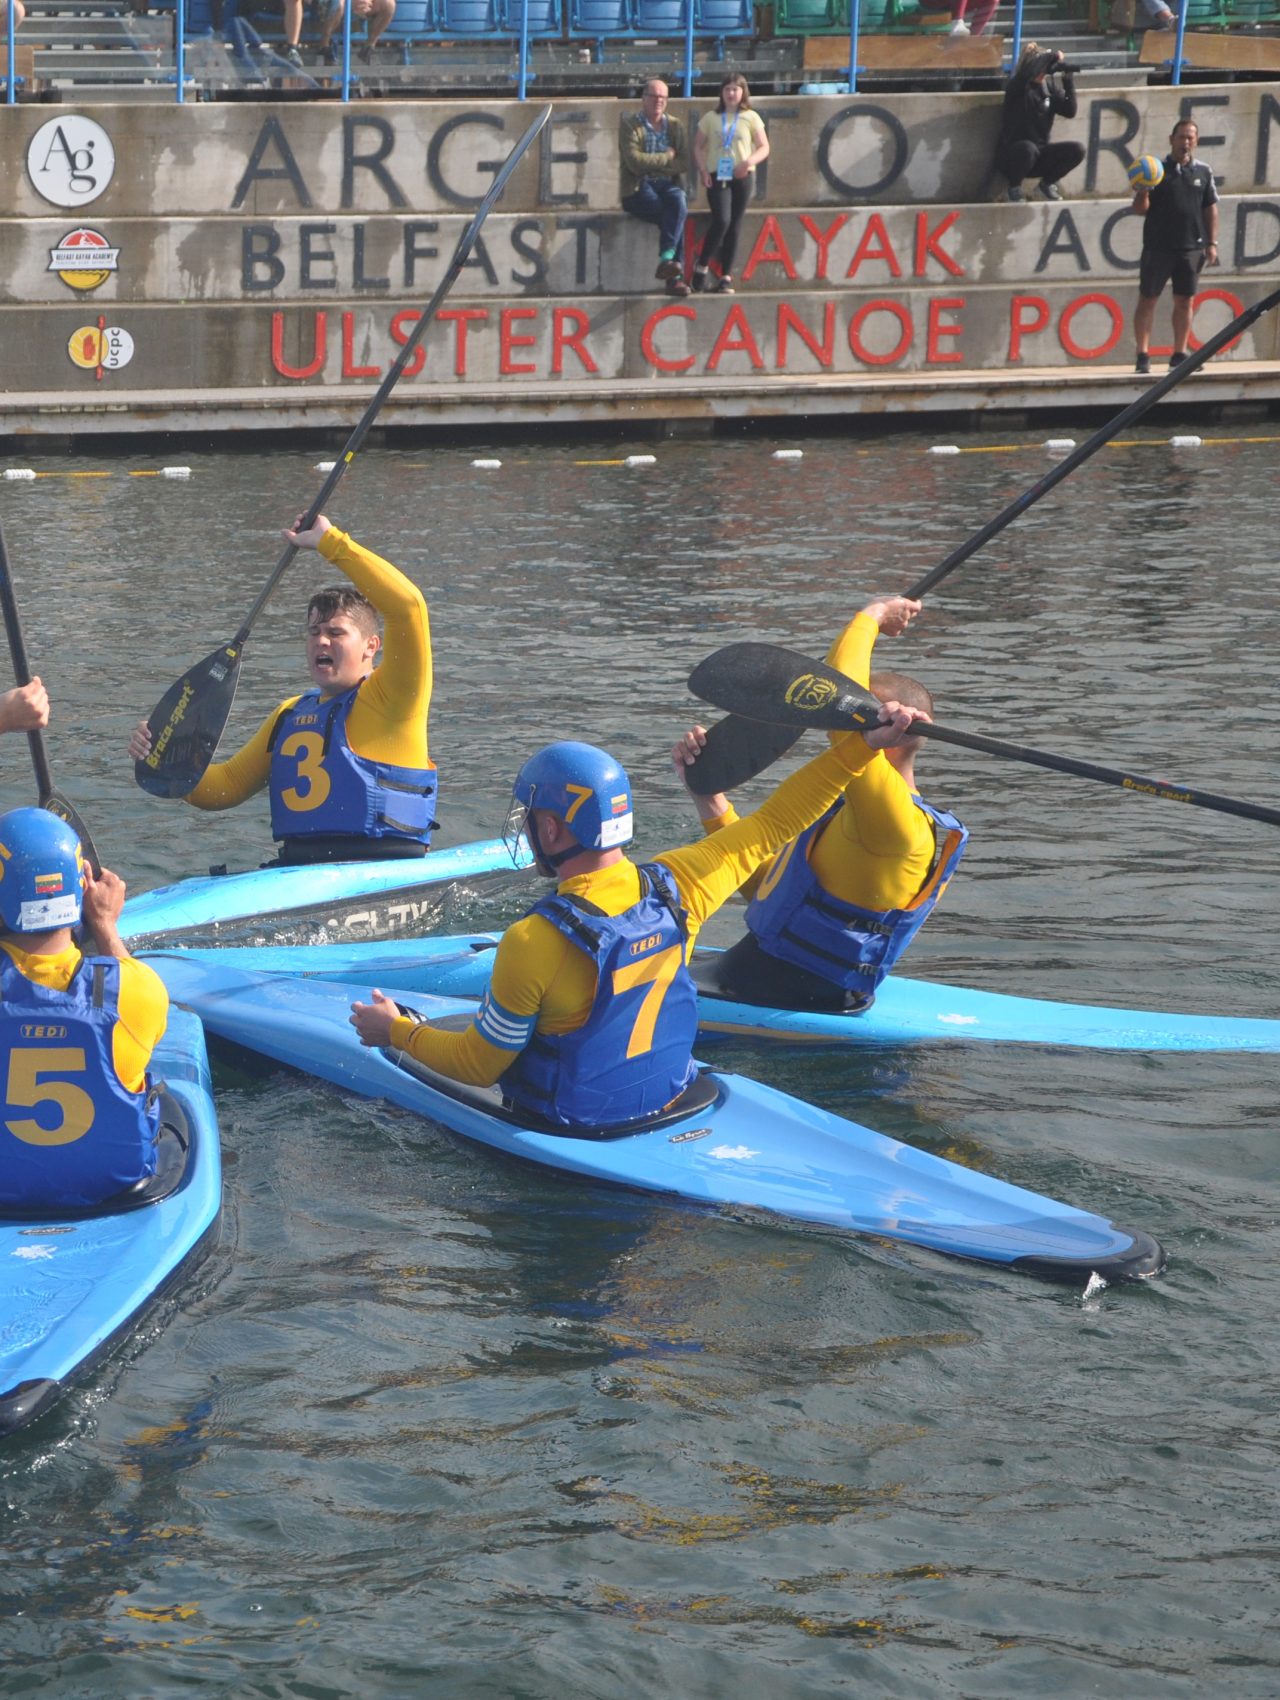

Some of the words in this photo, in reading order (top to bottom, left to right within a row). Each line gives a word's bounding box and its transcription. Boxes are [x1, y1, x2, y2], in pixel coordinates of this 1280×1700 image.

[40, 125, 96, 193] Ag
[241, 217, 604, 290] BELFAST
[272, 308, 599, 379] ULSTER
[641, 298, 965, 373] CANOE
[280, 731, 331, 812] 3
[565, 784, 593, 824] 7
[630, 933, 662, 956] TEDI
[23, 1025, 66, 1038] TEDI
[611, 943, 683, 1059] 7
[4, 1047, 96, 1146] 5
